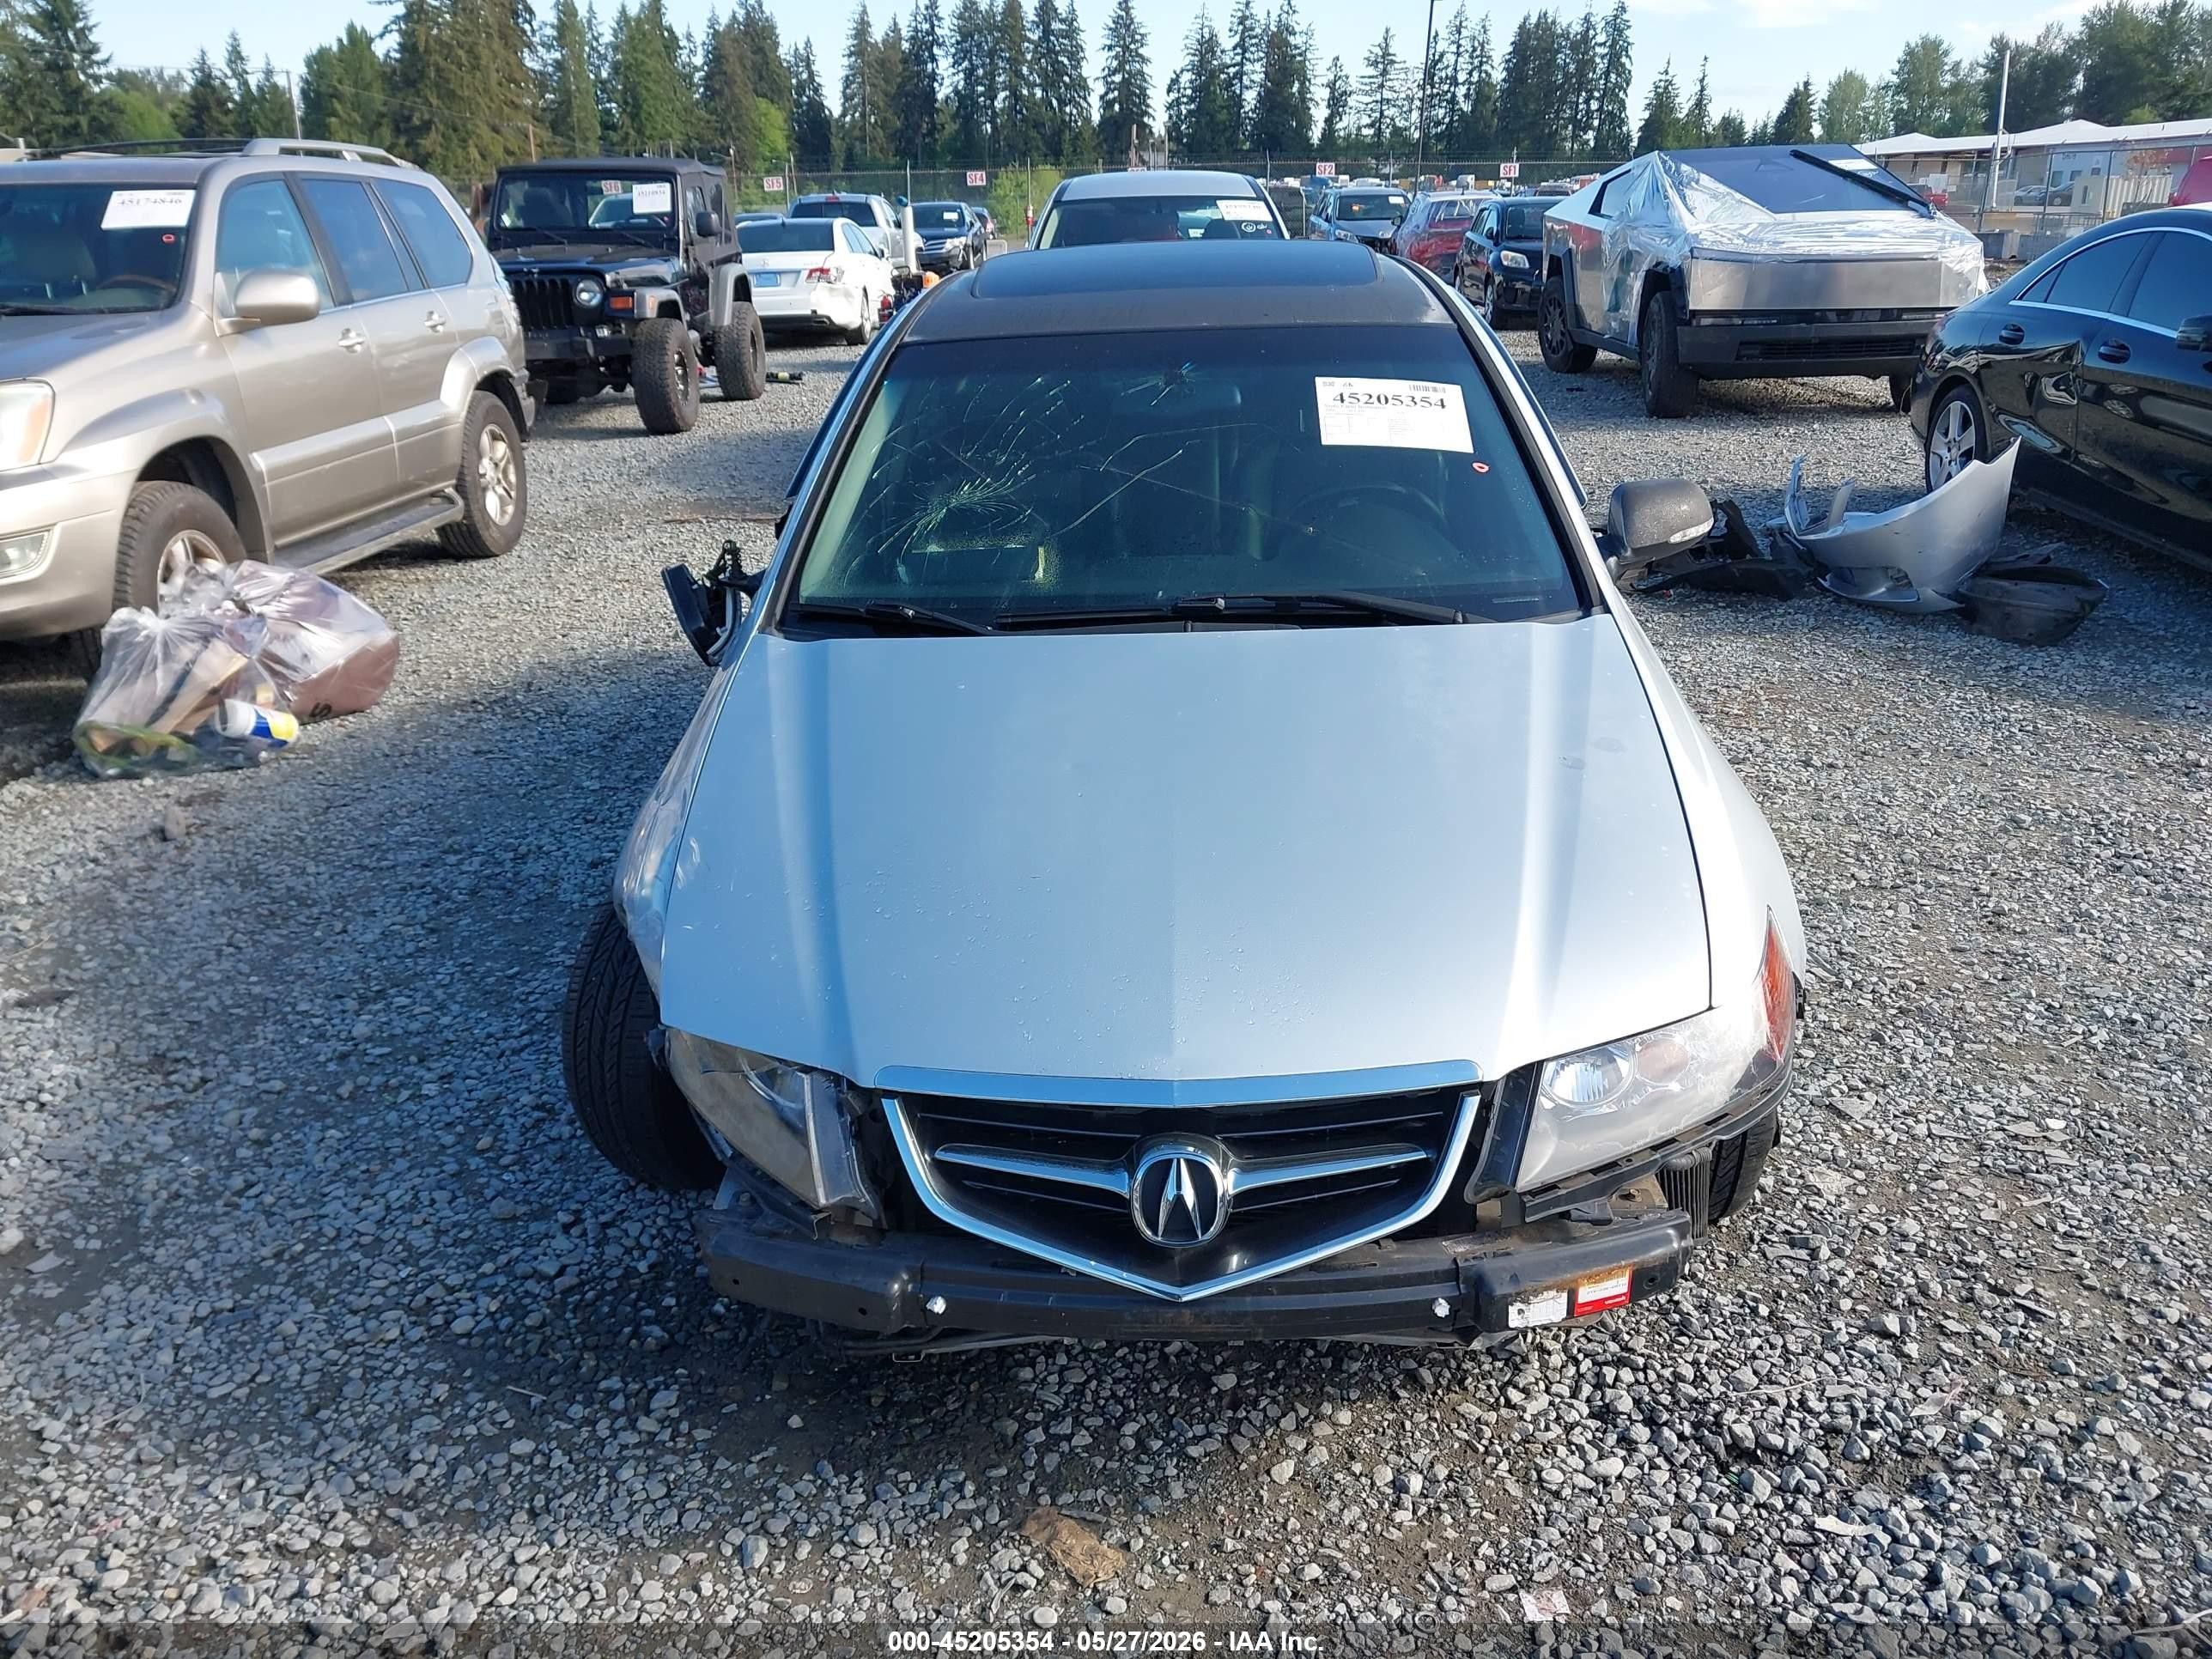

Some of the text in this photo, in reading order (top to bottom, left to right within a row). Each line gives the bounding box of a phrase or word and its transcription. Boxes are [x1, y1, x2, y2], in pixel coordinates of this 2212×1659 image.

[1317, 164, 1334, 175] SF2
[1503, 165, 1516, 176] SF1
[765, 178, 781, 189] SF5
[968, 173, 984, 184] SF4
[1333, 392, 1447, 410] 45205354
